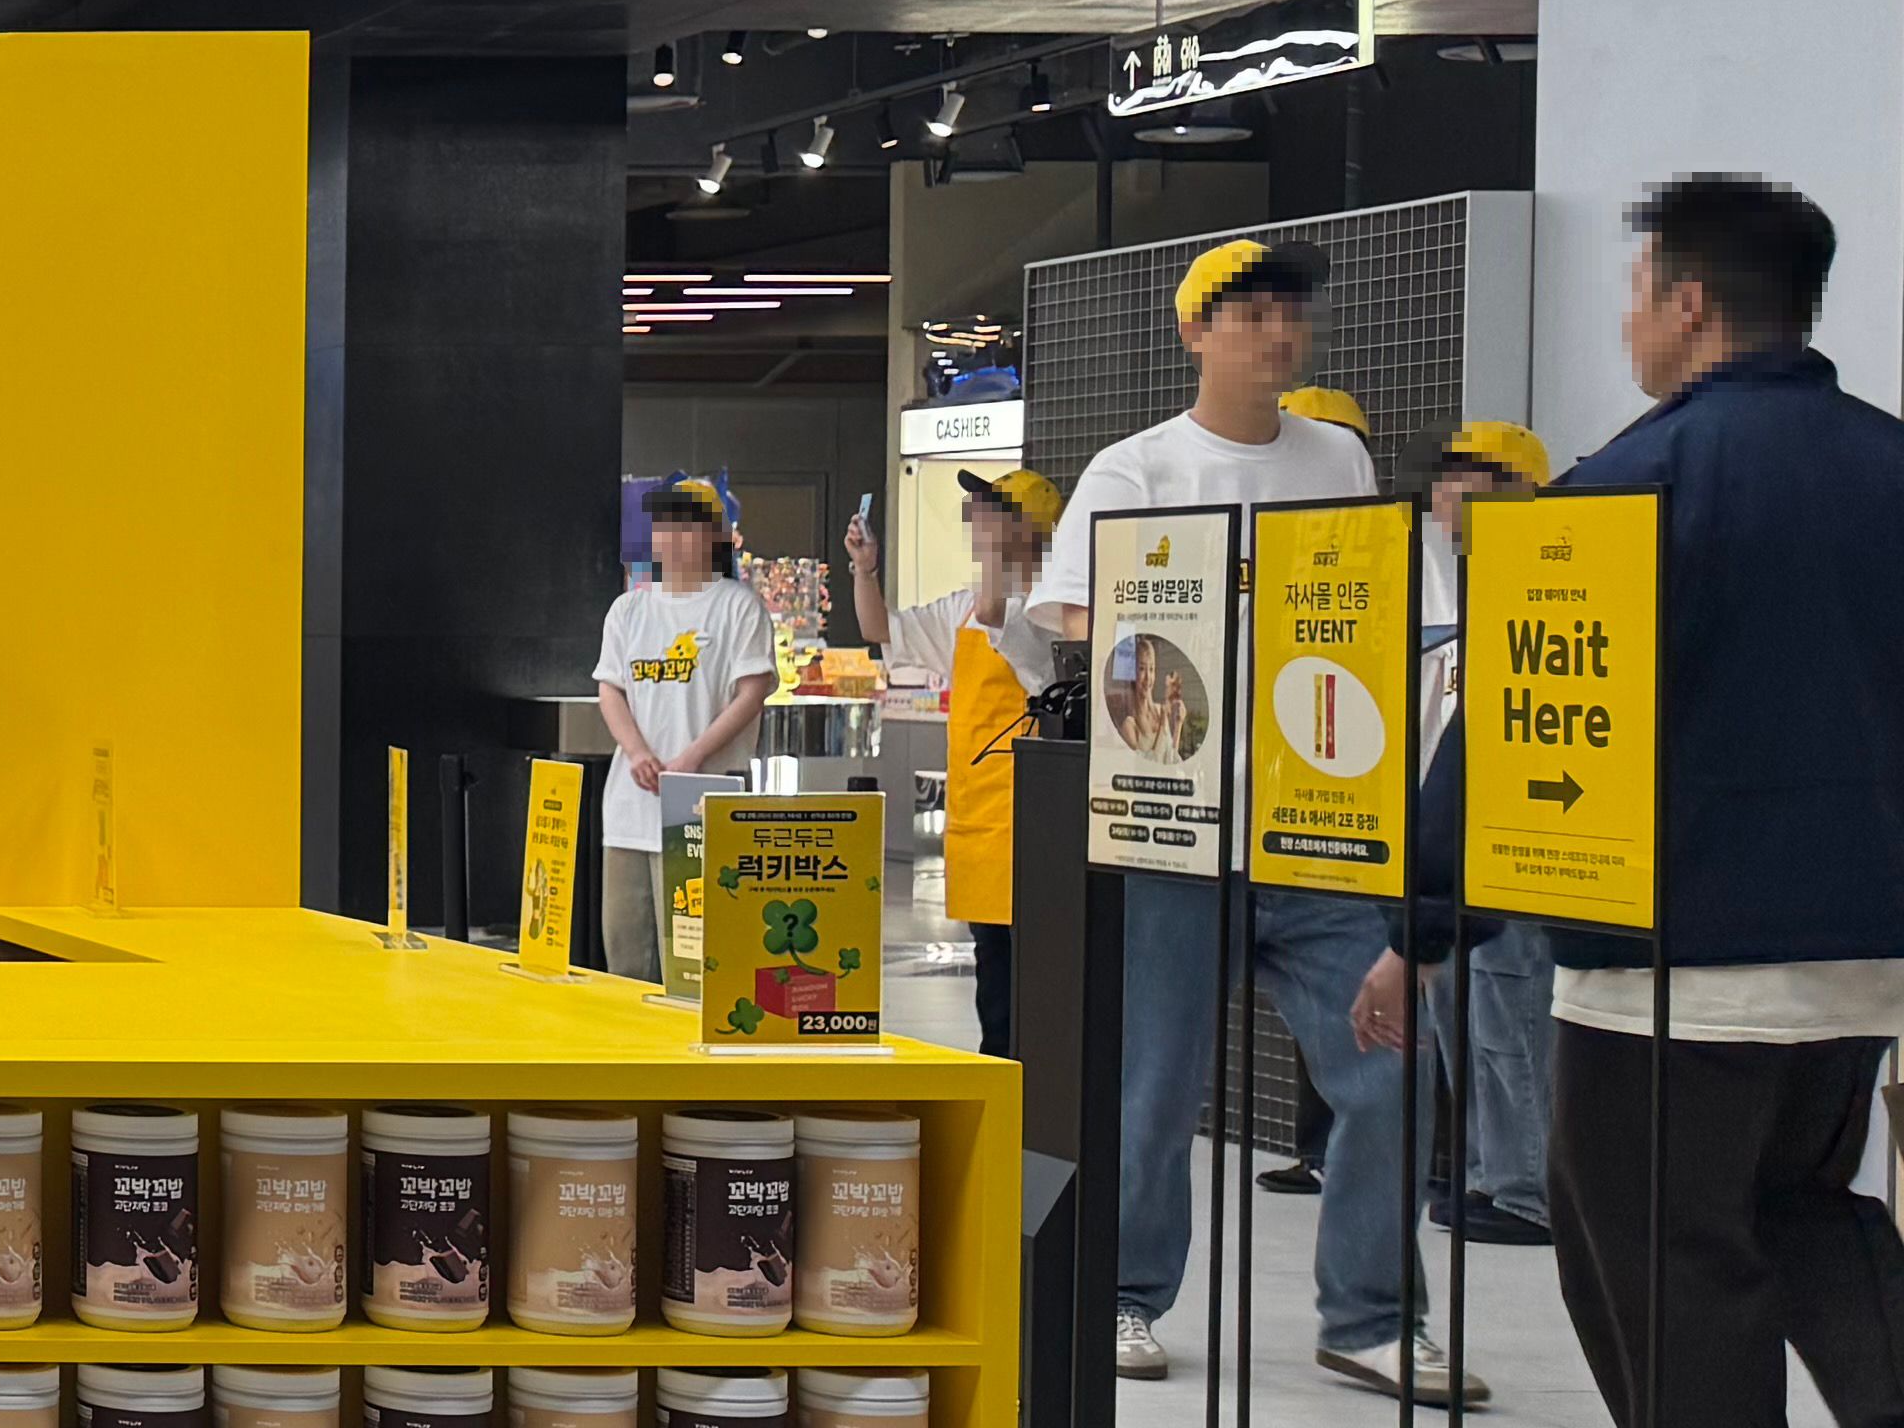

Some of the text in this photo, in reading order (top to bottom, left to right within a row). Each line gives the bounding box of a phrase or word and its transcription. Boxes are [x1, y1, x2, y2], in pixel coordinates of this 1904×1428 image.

[936, 416, 991, 440] CASHIER
[1113, 578, 1203, 604] 심으뜸 방문일정
[1284, 580, 1370, 612] 자사몰 인증
[1295, 619, 1358, 644] EVENT
[1506, 619, 1609, 678] Wait
[1504, 687, 1611, 748] Here
[1300, 809, 1307, 823] &
[1338, 812, 1354, 828] 2포
[753, 828, 834, 849] 두근두근
[738, 855, 849, 881] 럭키박스
[803, 1015, 877, 1033] 23,000원
[257, 1178, 326, 1200] 꼬박꼬밥
